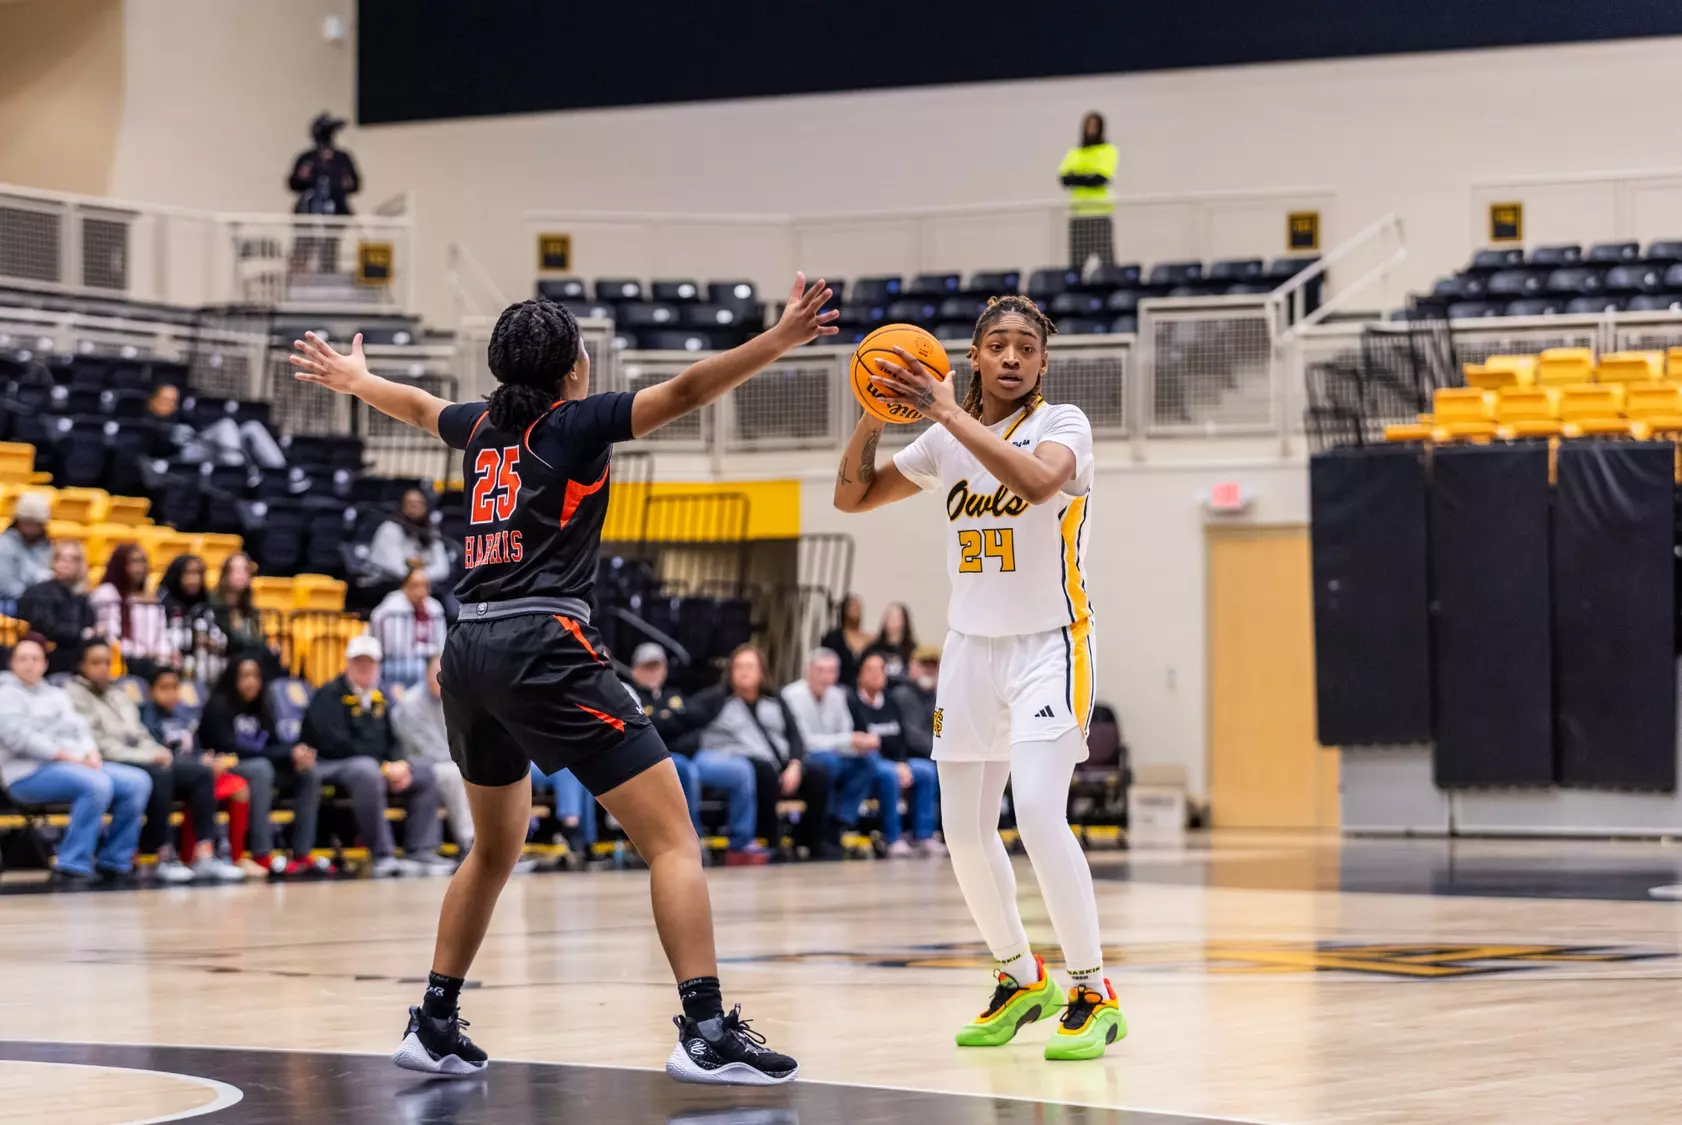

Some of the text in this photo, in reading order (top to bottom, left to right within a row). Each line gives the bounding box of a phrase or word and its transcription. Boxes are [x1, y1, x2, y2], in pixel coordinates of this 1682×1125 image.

[470, 444, 521, 525] 25
[946, 479, 1030, 522] Owls
[957, 528, 1016, 573] 24
